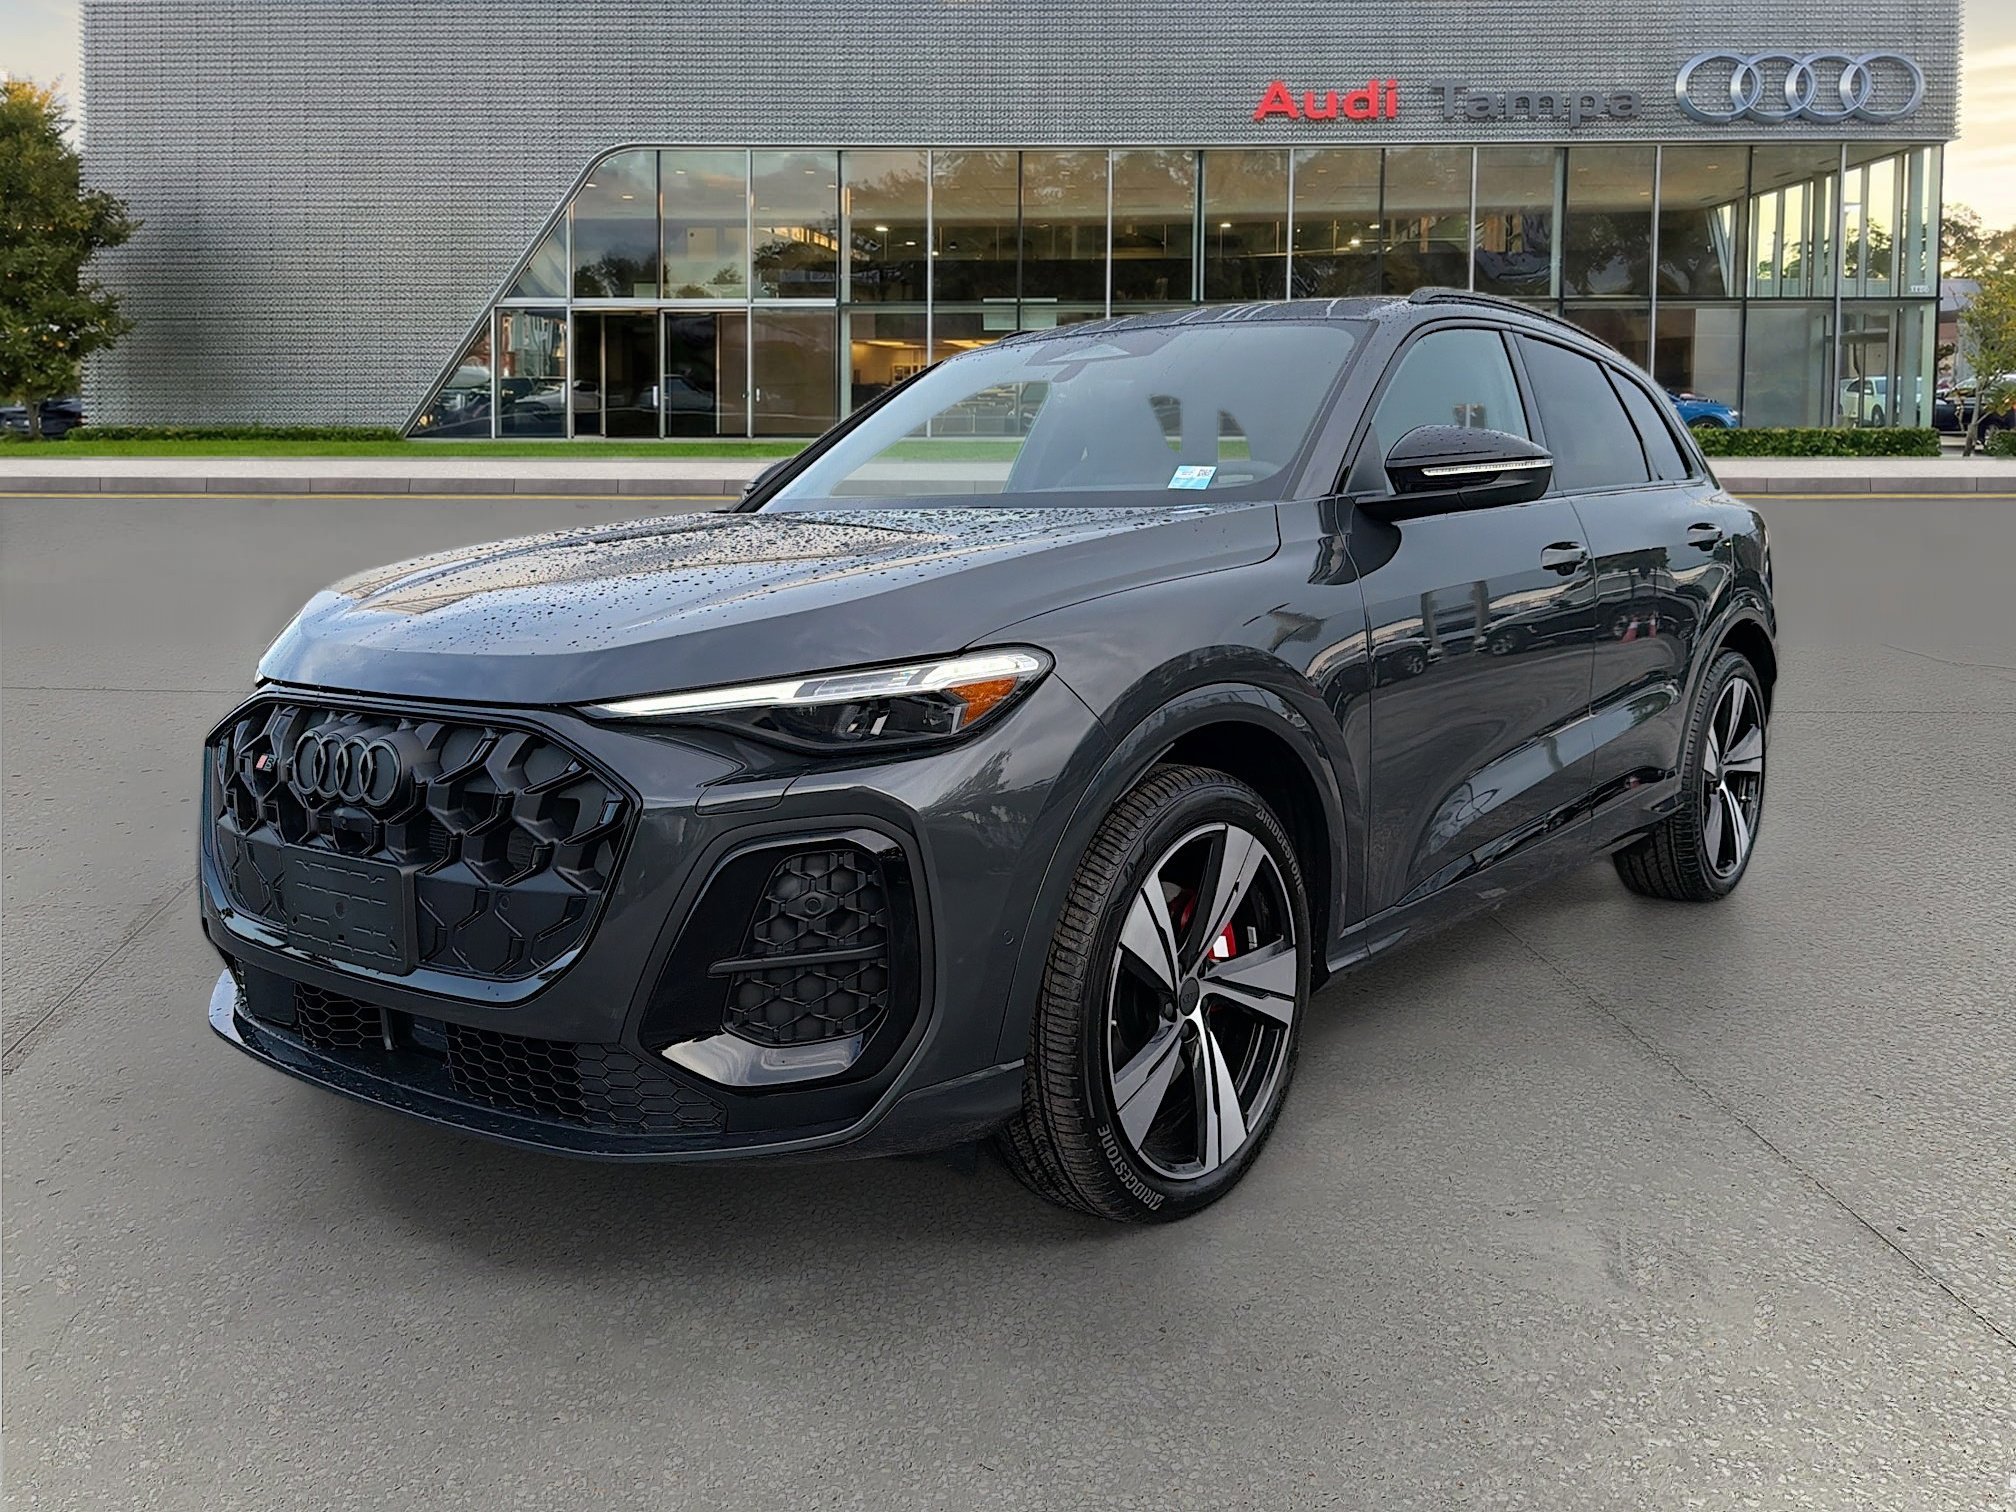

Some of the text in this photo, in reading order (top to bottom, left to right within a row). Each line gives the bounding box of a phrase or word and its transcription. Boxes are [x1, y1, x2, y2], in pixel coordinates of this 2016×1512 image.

[1253, 78, 1642, 128] Audi Tampa
[1097, 1123, 1166, 1211] BRIDGESTONE
